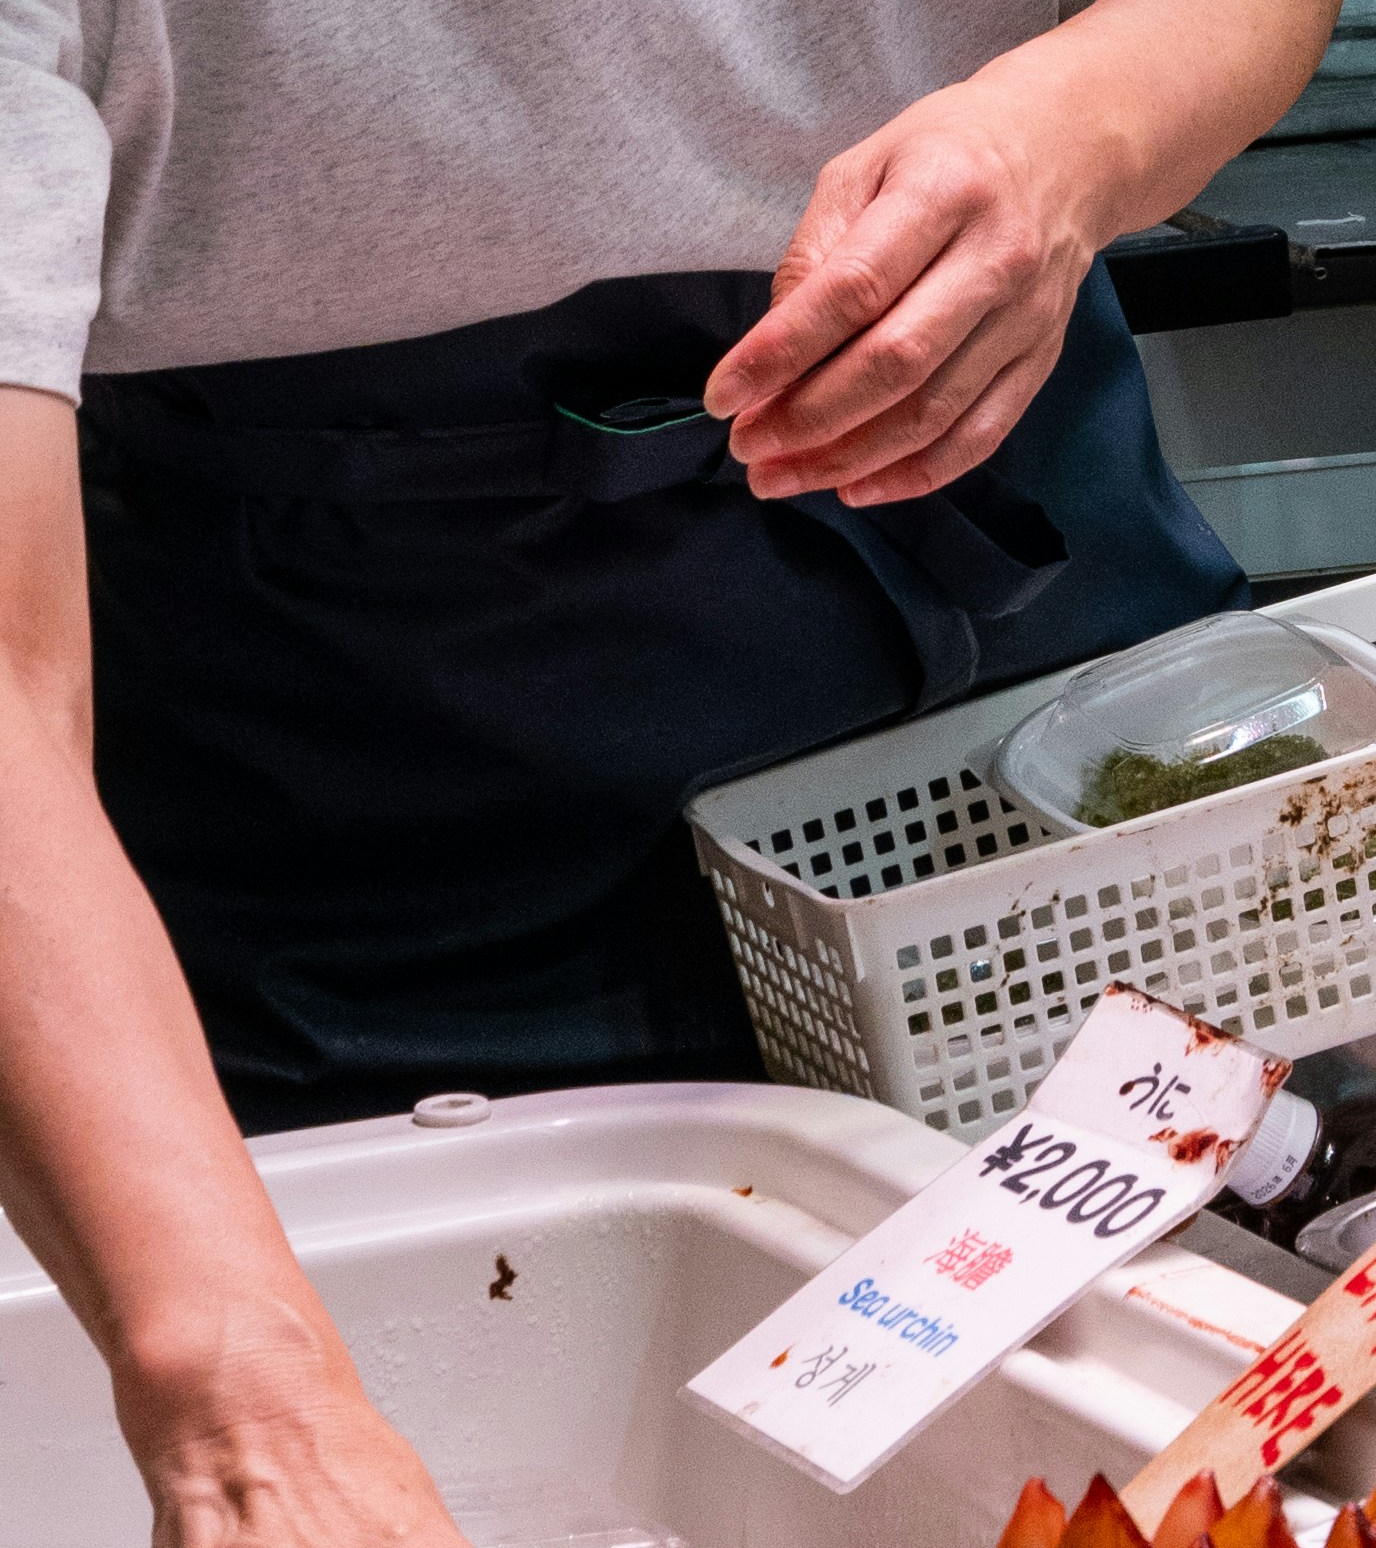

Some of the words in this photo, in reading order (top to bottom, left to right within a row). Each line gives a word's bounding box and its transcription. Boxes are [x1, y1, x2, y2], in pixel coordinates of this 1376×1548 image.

[1118, 1062, 1192, 1123] うに
[978, 1122, 1168, 1241] ¥2,000
[838, 1277, 889, 1322] sea
[879, 1302, 960, 1358] urchin
[1220, 1328, 1345, 1469] HERE
